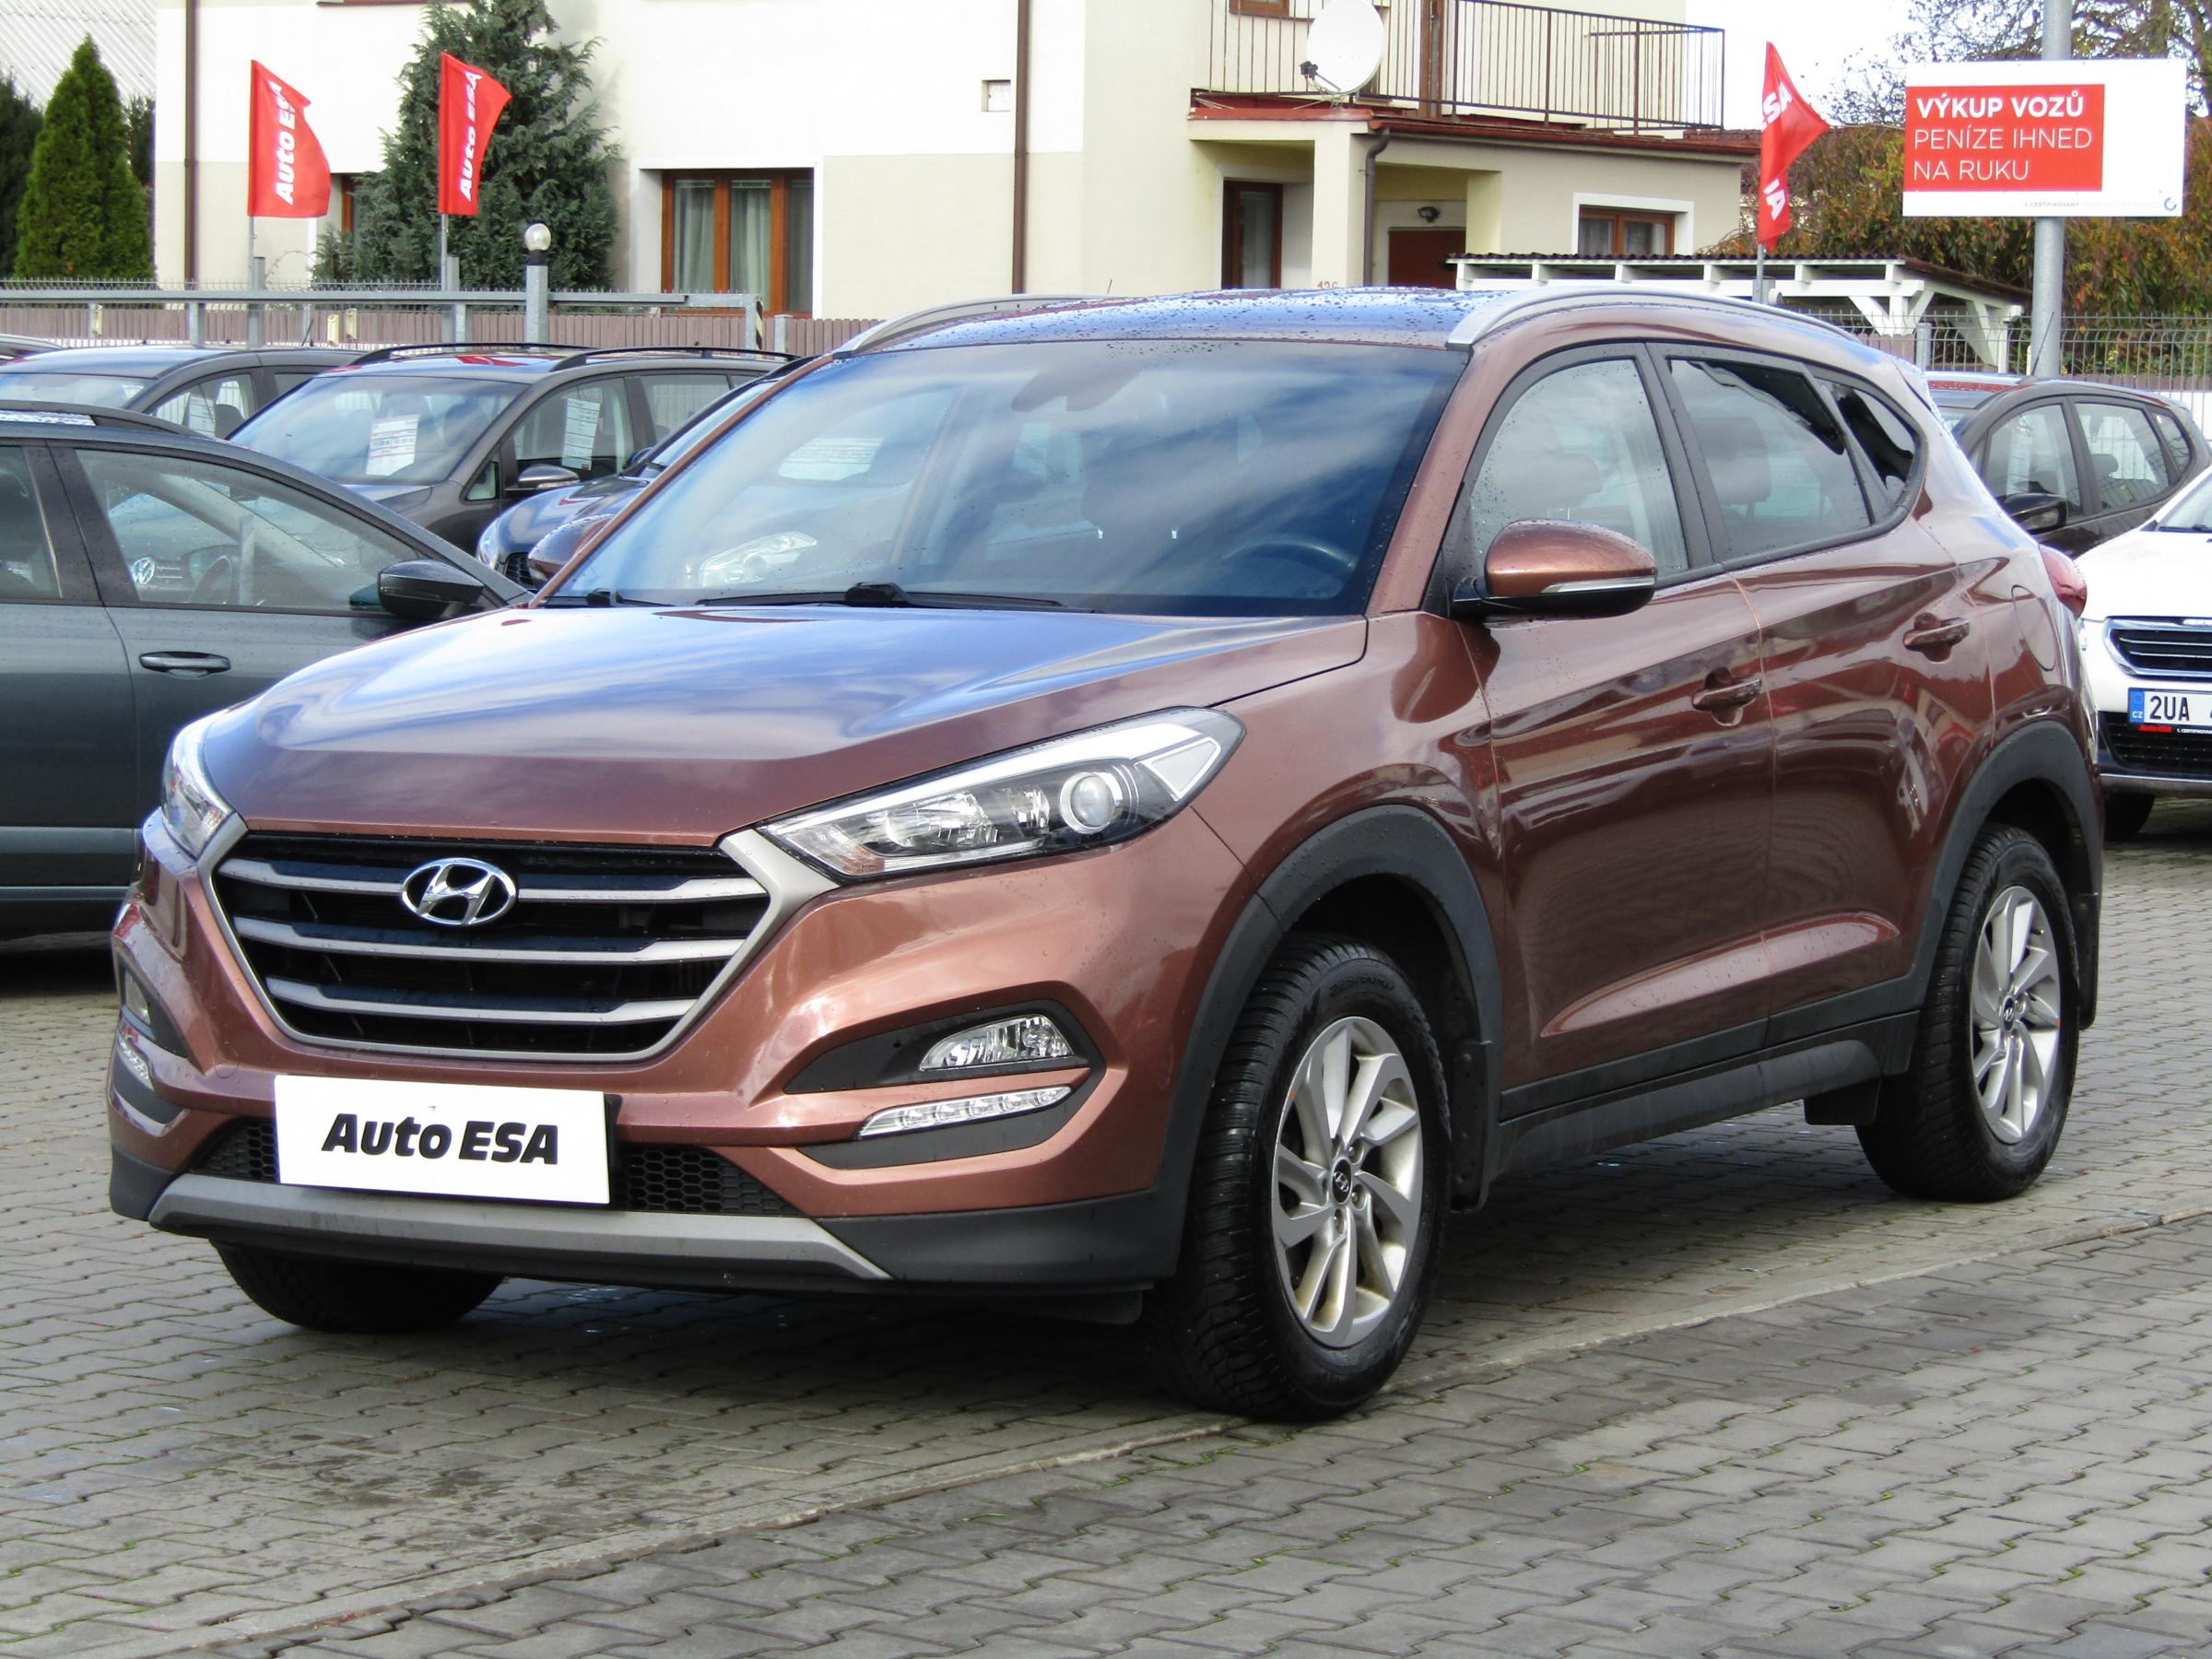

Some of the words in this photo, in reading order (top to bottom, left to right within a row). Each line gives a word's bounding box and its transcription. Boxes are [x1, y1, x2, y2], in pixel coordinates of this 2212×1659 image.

[465, 70, 483, 123] ESA
[1916, 93, 2004, 119] VÝKUP
[2010, 89, 2084, 118] VOZŮ
[1913, 124, 2004, 149] PENÍZE
[2012, 127, 2092, 149] IHNED
[275, 131, 296, 206] Auto
[459, 125, 477, 202] Auto
[1912, 160, 1950, 181] NA
[1959, 159, 2030, 181] RUKU
[2132, 710, 2144, 719] CZ
[2149, 695, 2190, 722] 2UA
[321, 1112, 453, 1159] Auto
[458, 1120, 559, 1166] ESA
